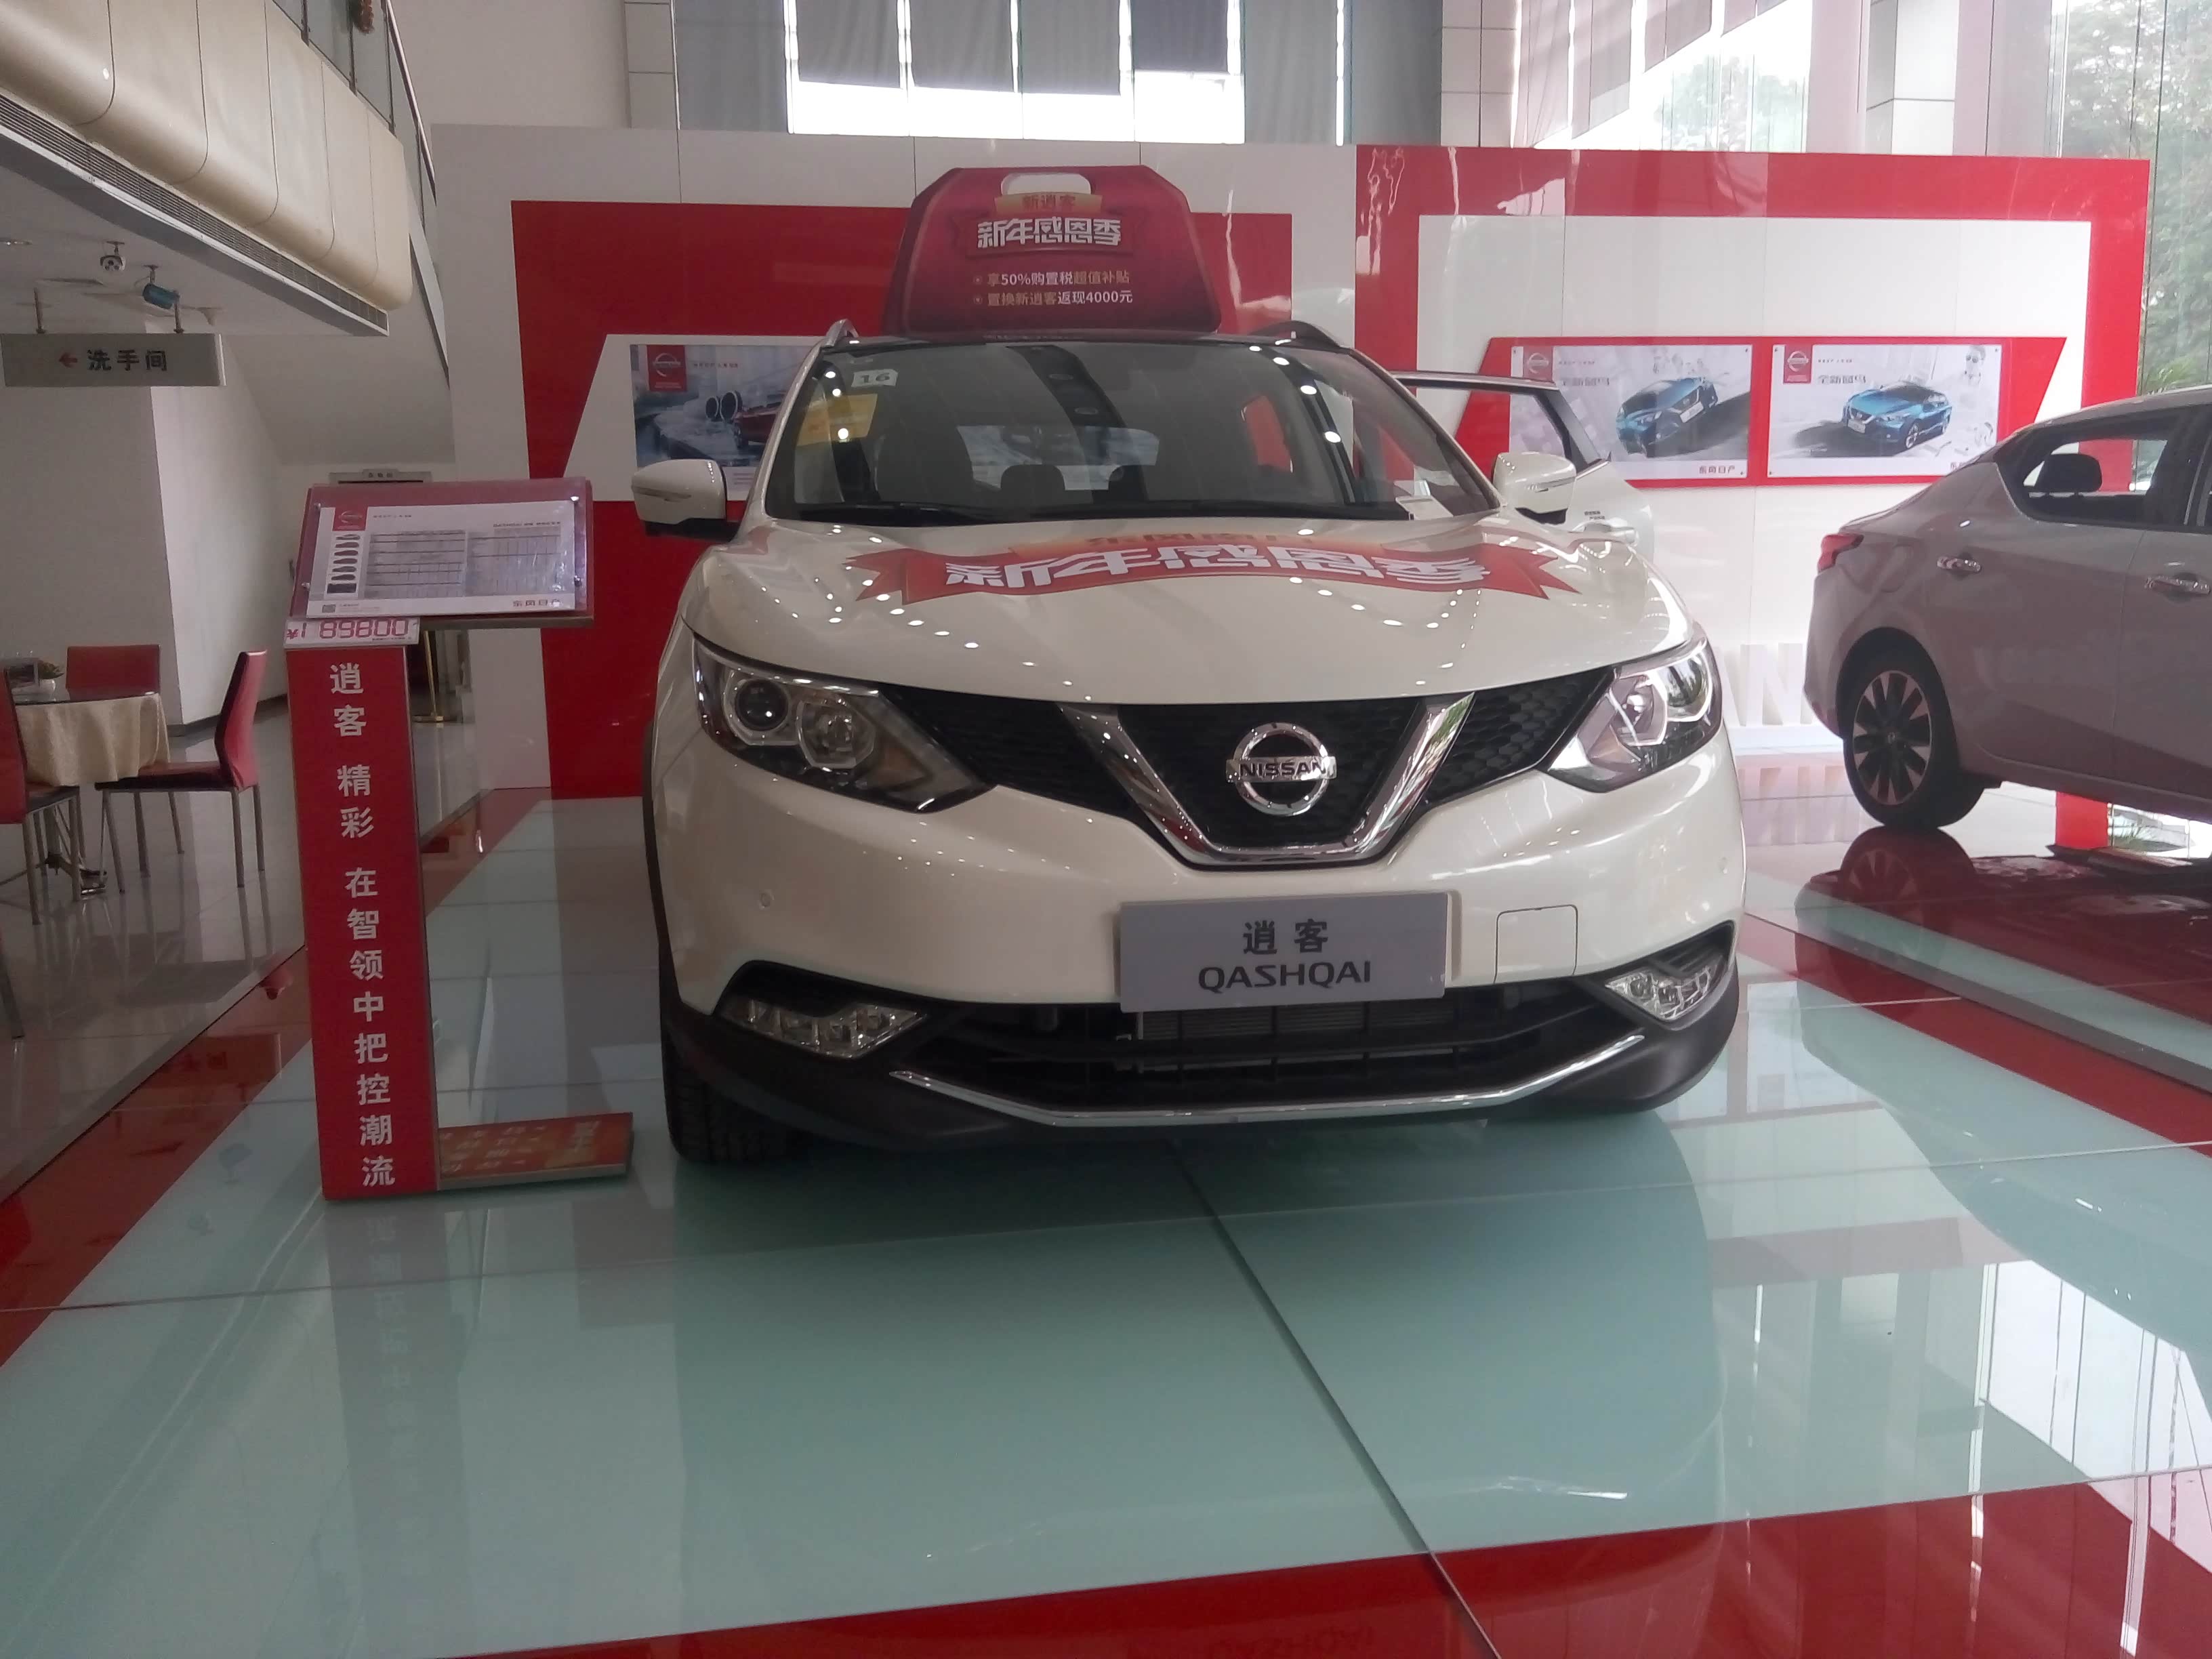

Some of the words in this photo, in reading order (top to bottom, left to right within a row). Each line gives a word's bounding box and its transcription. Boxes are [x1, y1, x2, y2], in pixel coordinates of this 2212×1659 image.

[1022, 194, 1076, 210] 新逍客
[977, 216, 1122, 248] 新年感恩季
[987, 268, 1130, 287] 享50%购置税超值补贴
[987, 289, 1133, 306] 置换新逍客返现4000元
[87, 348, 167, 371] 洗手间
[945, 544, 1491, 588] 新年感恩季
[329, 663, 368, 737] 逍客
[1240, 761, 1328, 777] NISSAN
[336, 764, 375, 840] 精彩
[1242, 918, 1328, 954] 逍客
[1198, 960, 1372, 994] QASHQAI
[344, 866, 396, 1187] 在智领中把控潮流
